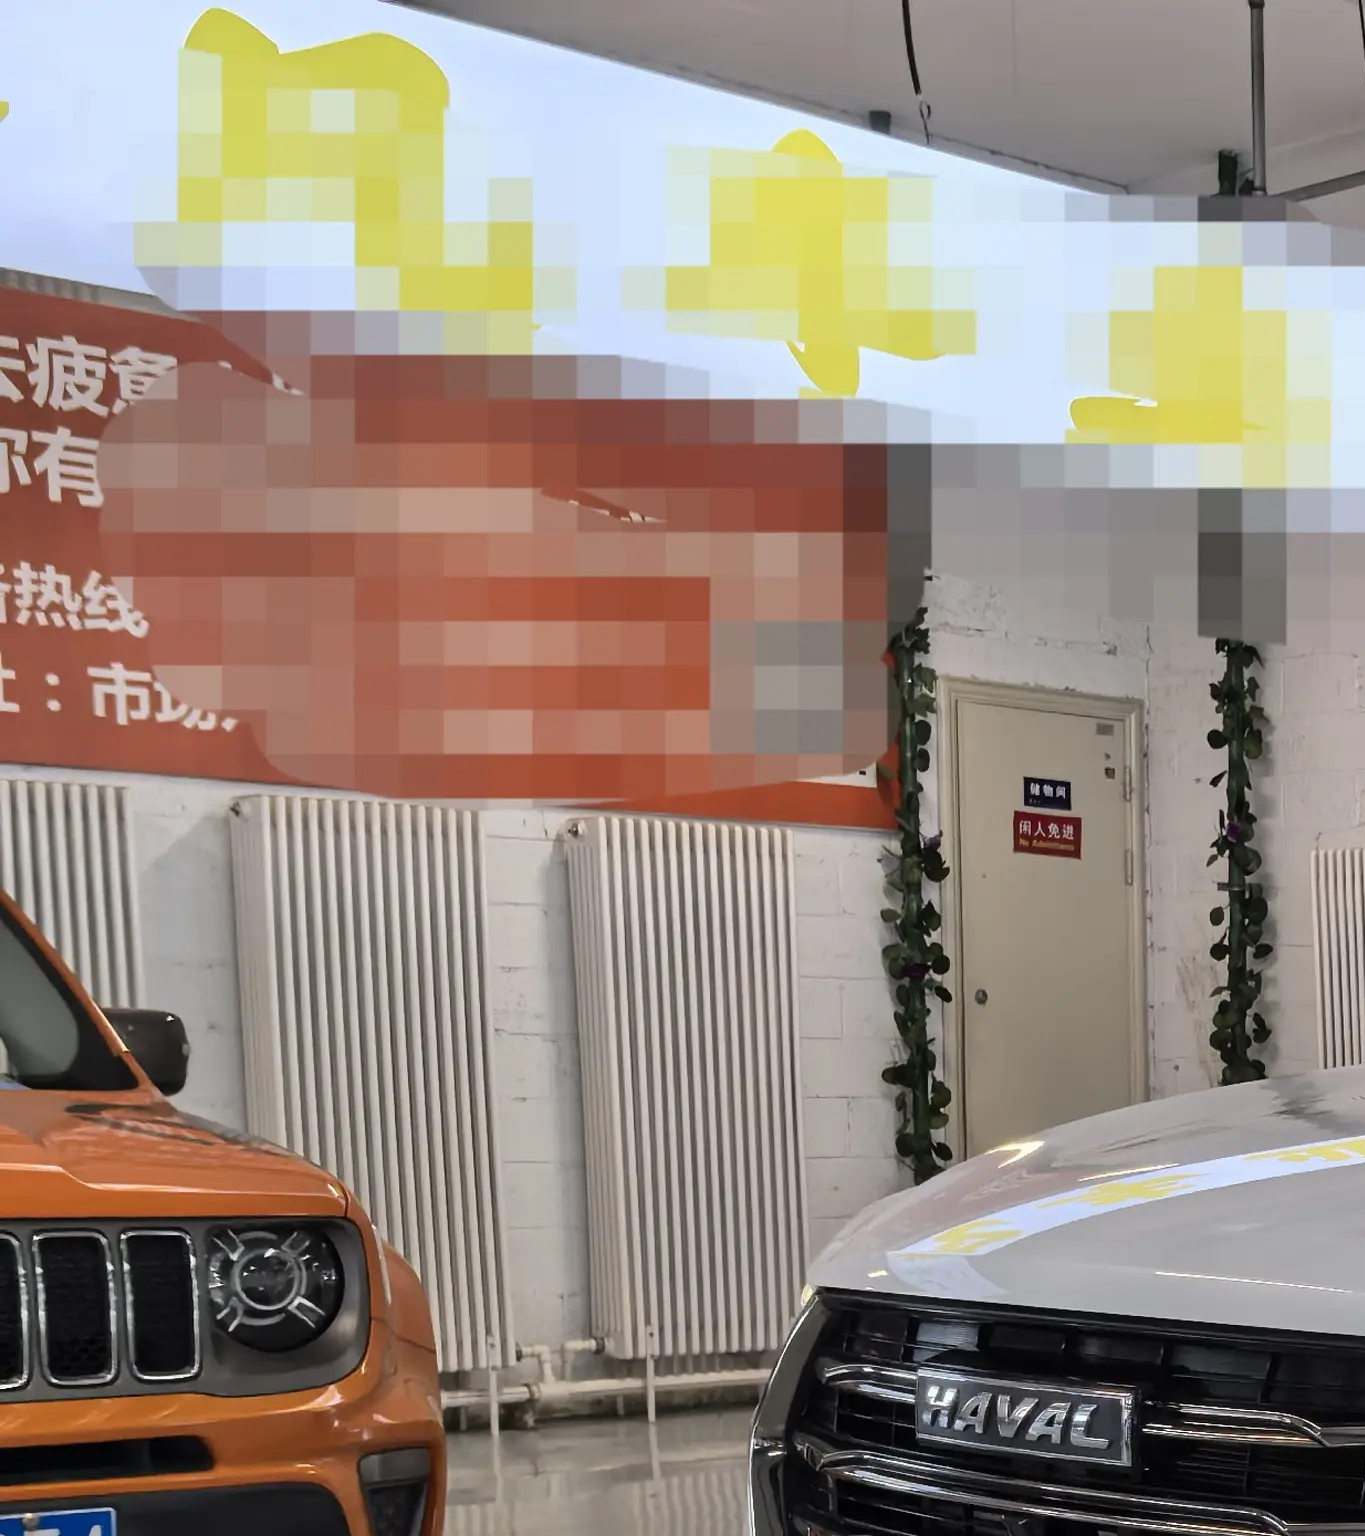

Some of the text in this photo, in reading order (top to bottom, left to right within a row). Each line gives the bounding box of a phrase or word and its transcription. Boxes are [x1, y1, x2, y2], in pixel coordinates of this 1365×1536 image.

[0, 561, 150, 638] 热线
[1019, 820, 1075, 840] 闲人免进
[926, 1385, 1114, 1451] HAVAL
